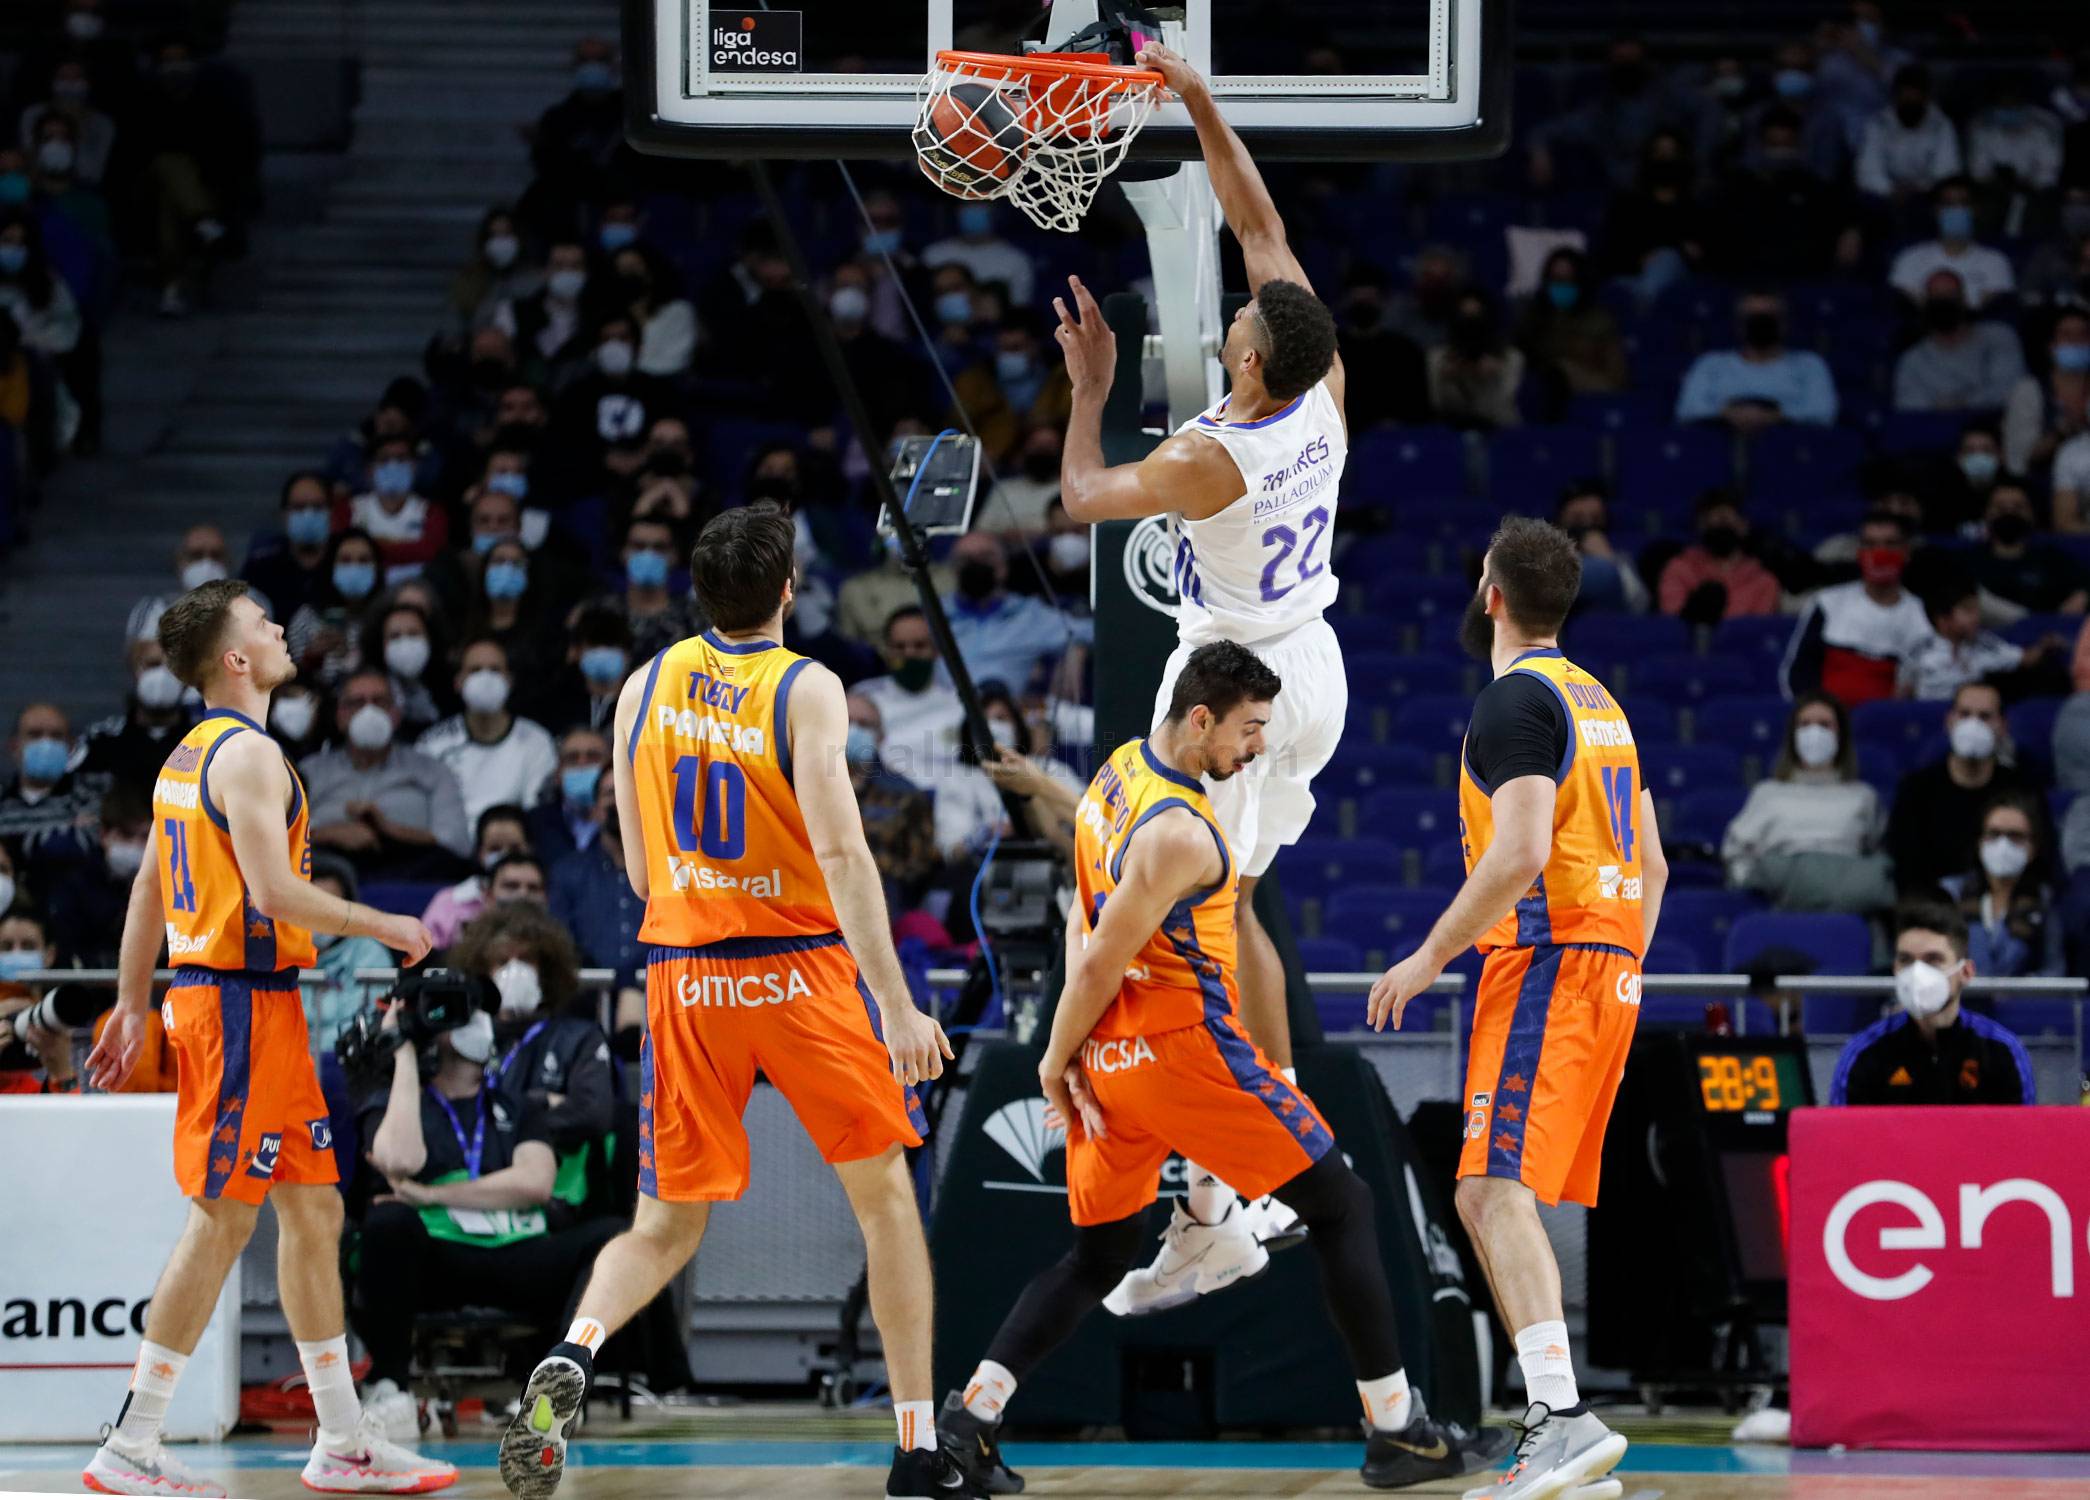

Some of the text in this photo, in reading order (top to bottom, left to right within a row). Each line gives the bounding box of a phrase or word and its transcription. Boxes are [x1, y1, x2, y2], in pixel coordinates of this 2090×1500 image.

[713, 27, 751, 49] liga
[713, 47, 797, 66] endesa
[1253, 462, 1334, 515] PALLADIUM
[1259, 504, 1329, 603] 22
[671, 755, 746, 860] 10
[1823, 1177, 2090, 1301] en
